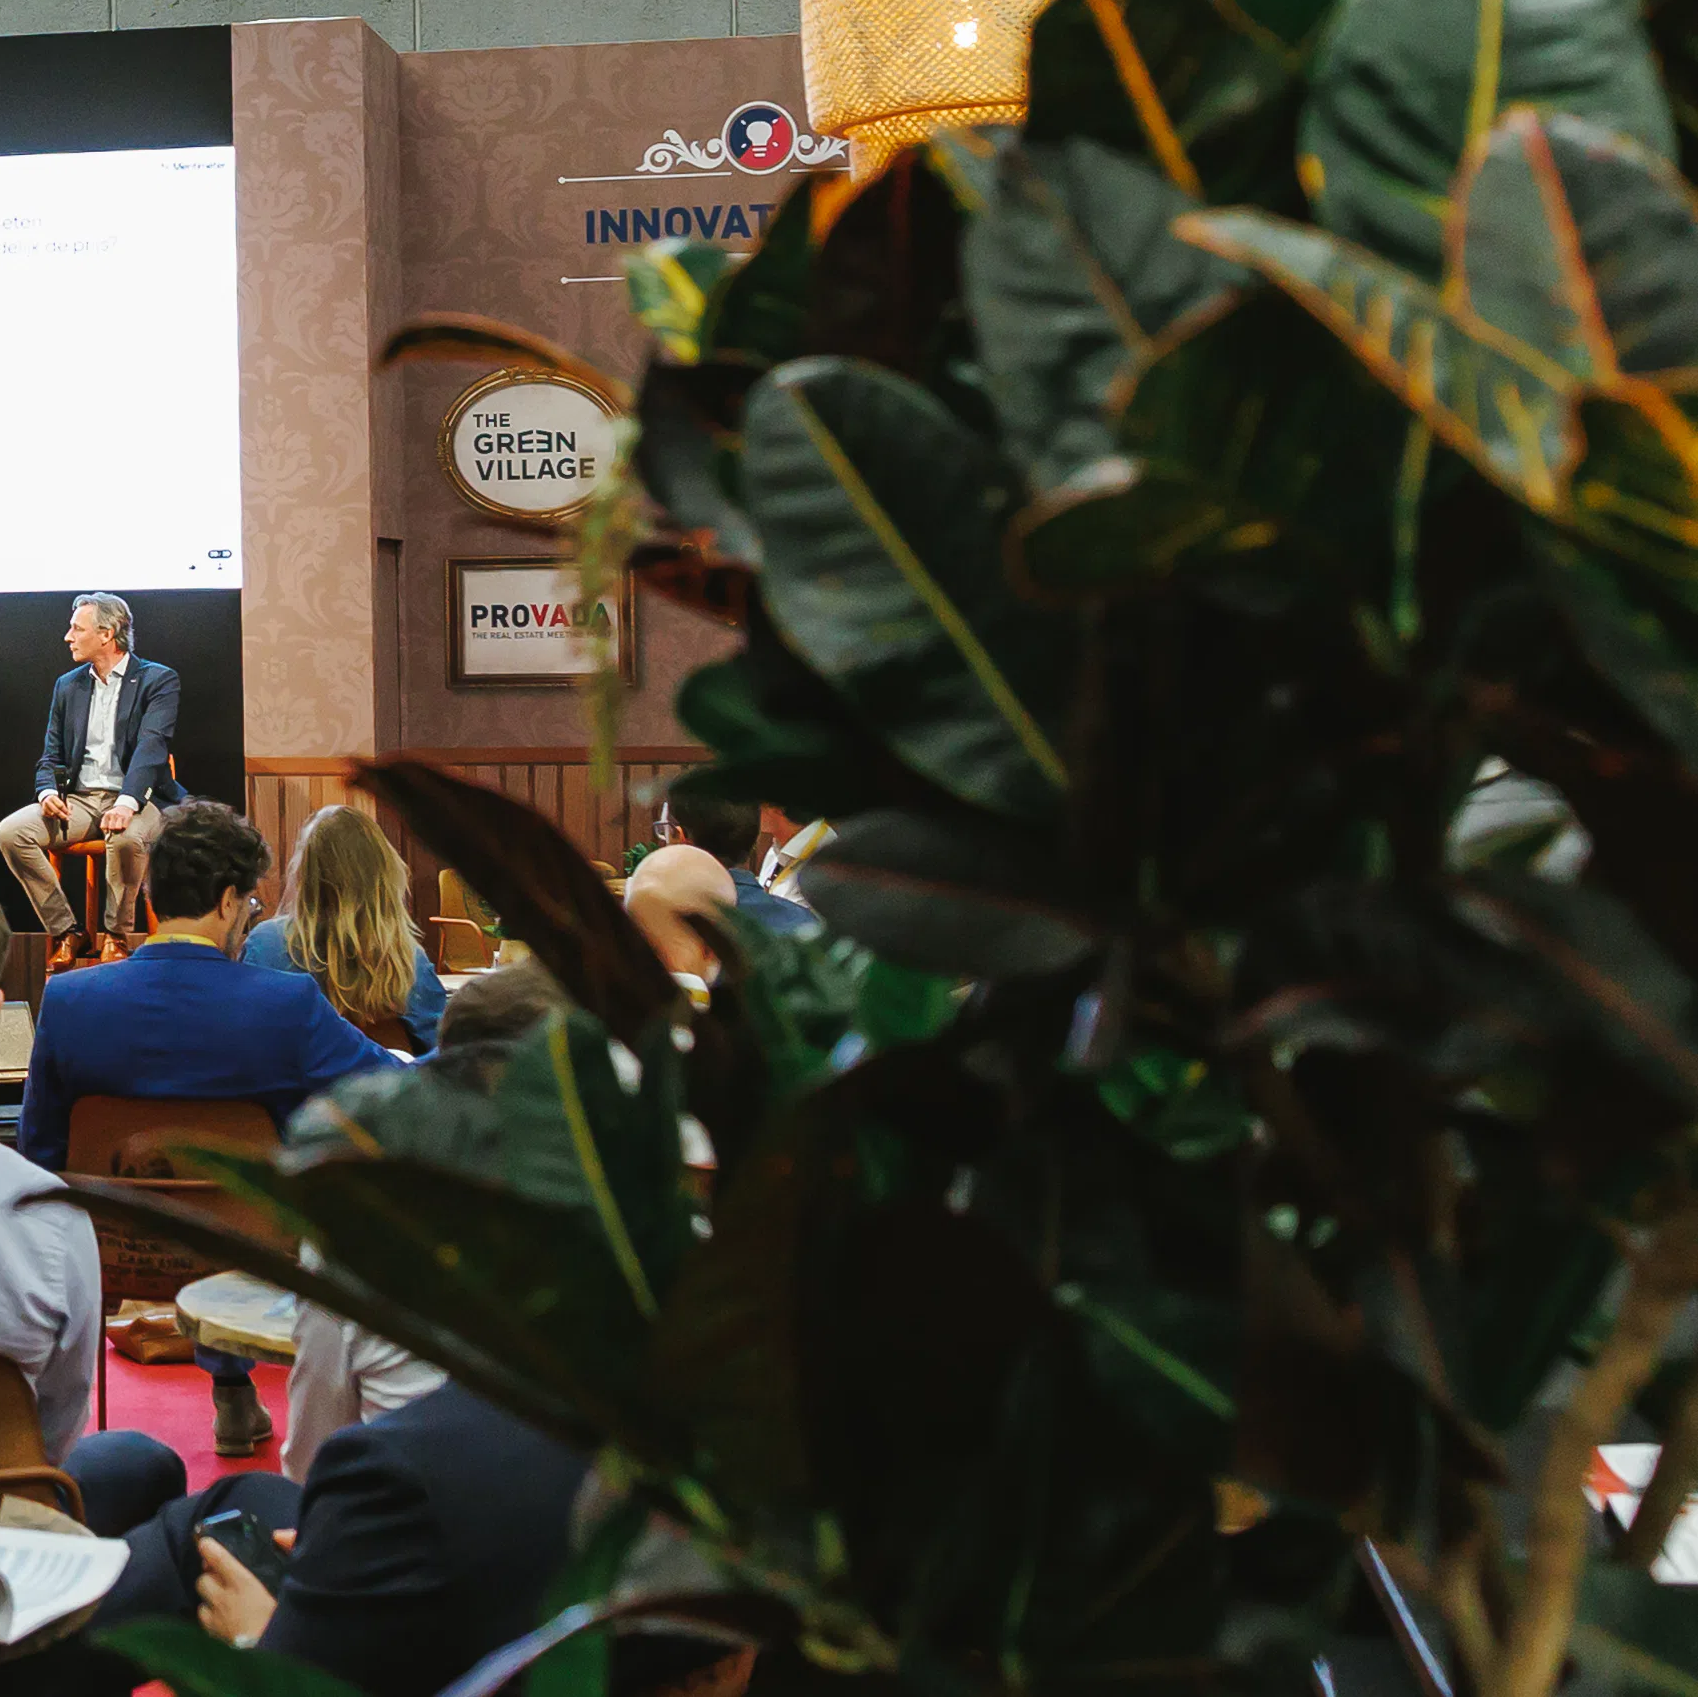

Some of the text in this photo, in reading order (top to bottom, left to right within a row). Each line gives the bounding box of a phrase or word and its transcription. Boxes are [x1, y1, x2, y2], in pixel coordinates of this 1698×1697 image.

[586, 204, 776, 244] INNOVAT
[472, 413, 511, 428] THE
[473, 429, 576, 454] GREEN
[474, 457, 596, 481] VILLAGE
